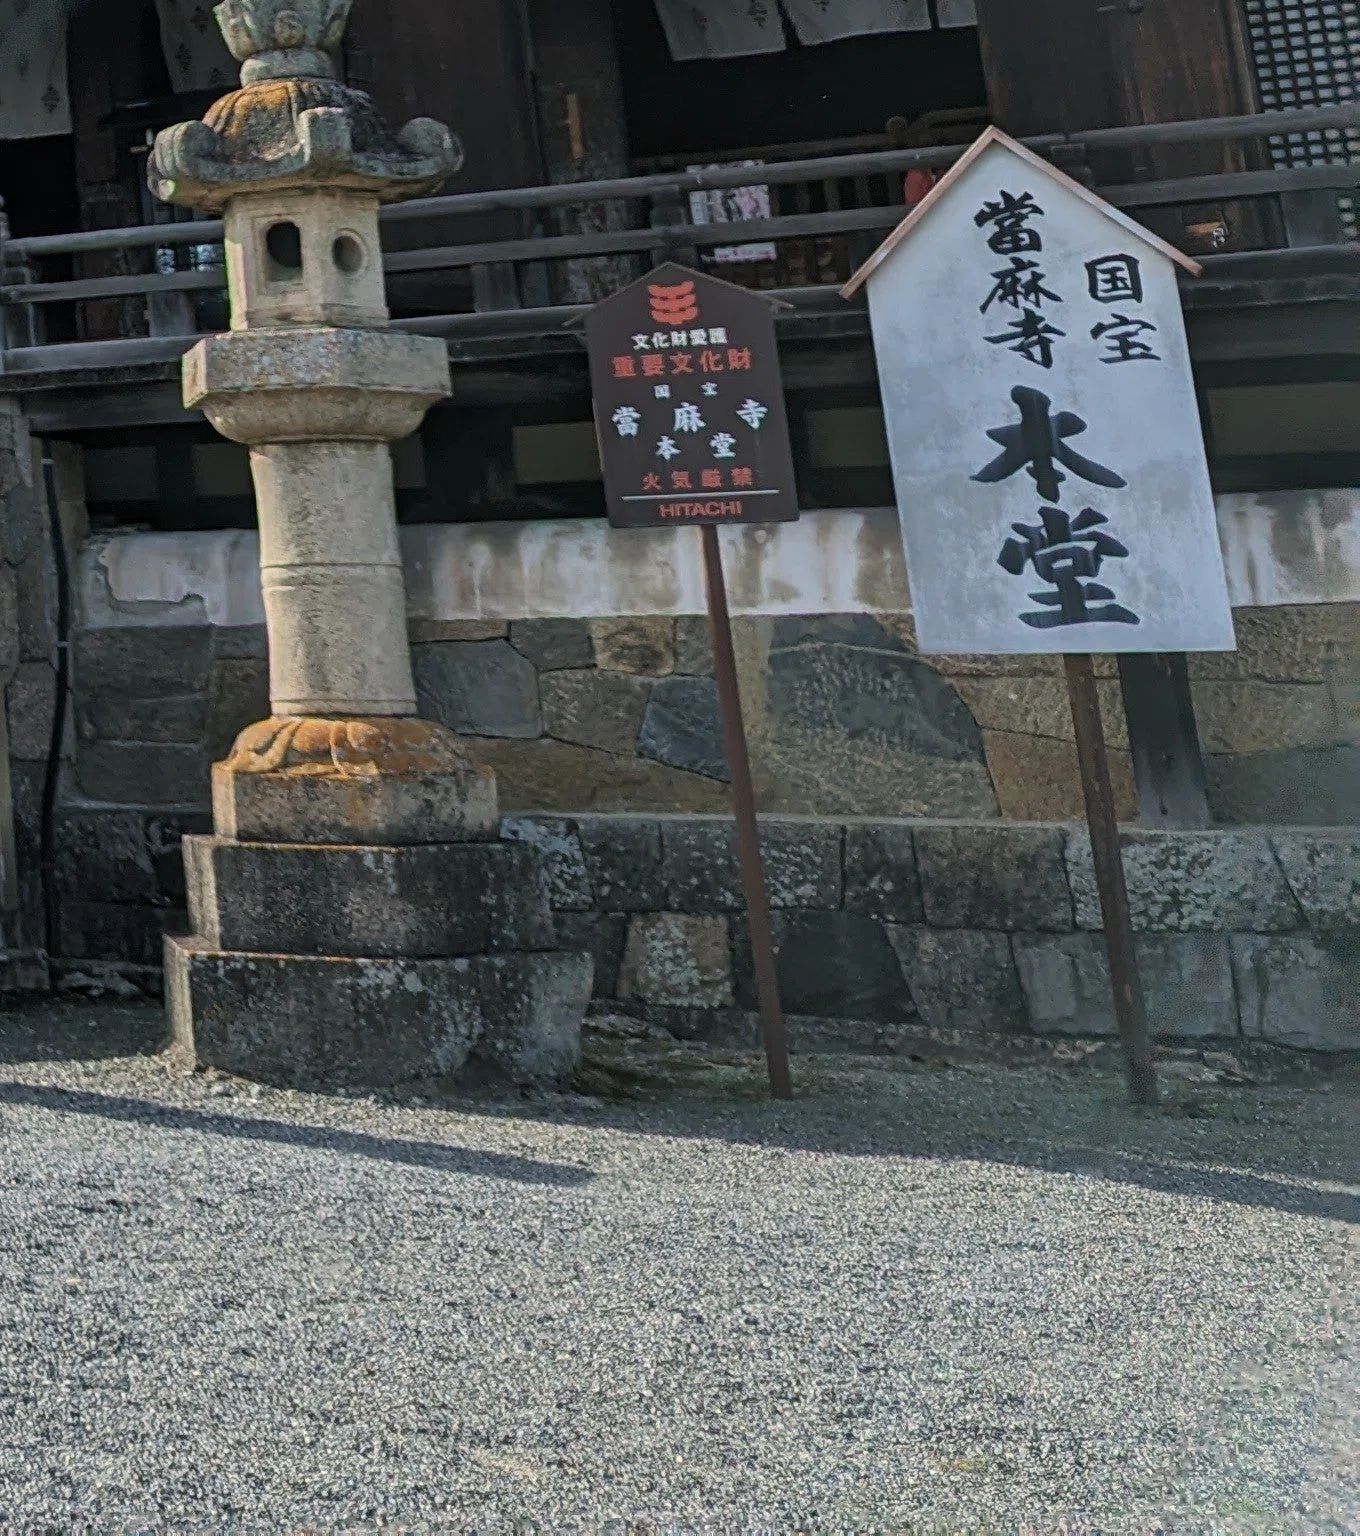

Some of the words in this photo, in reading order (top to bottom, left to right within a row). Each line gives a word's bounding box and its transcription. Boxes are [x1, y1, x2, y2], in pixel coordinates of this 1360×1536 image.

[973, 190, 1066, 368] 當麻寺
[1084, 253, 1161, 363] 国宝
[612, 347, 752, 378] 重要文化財
[655, 432, 737, 460] 本堂
[659, 500, 743, 518] HITACHI
[969, 385, 1141, 629] 本堂
